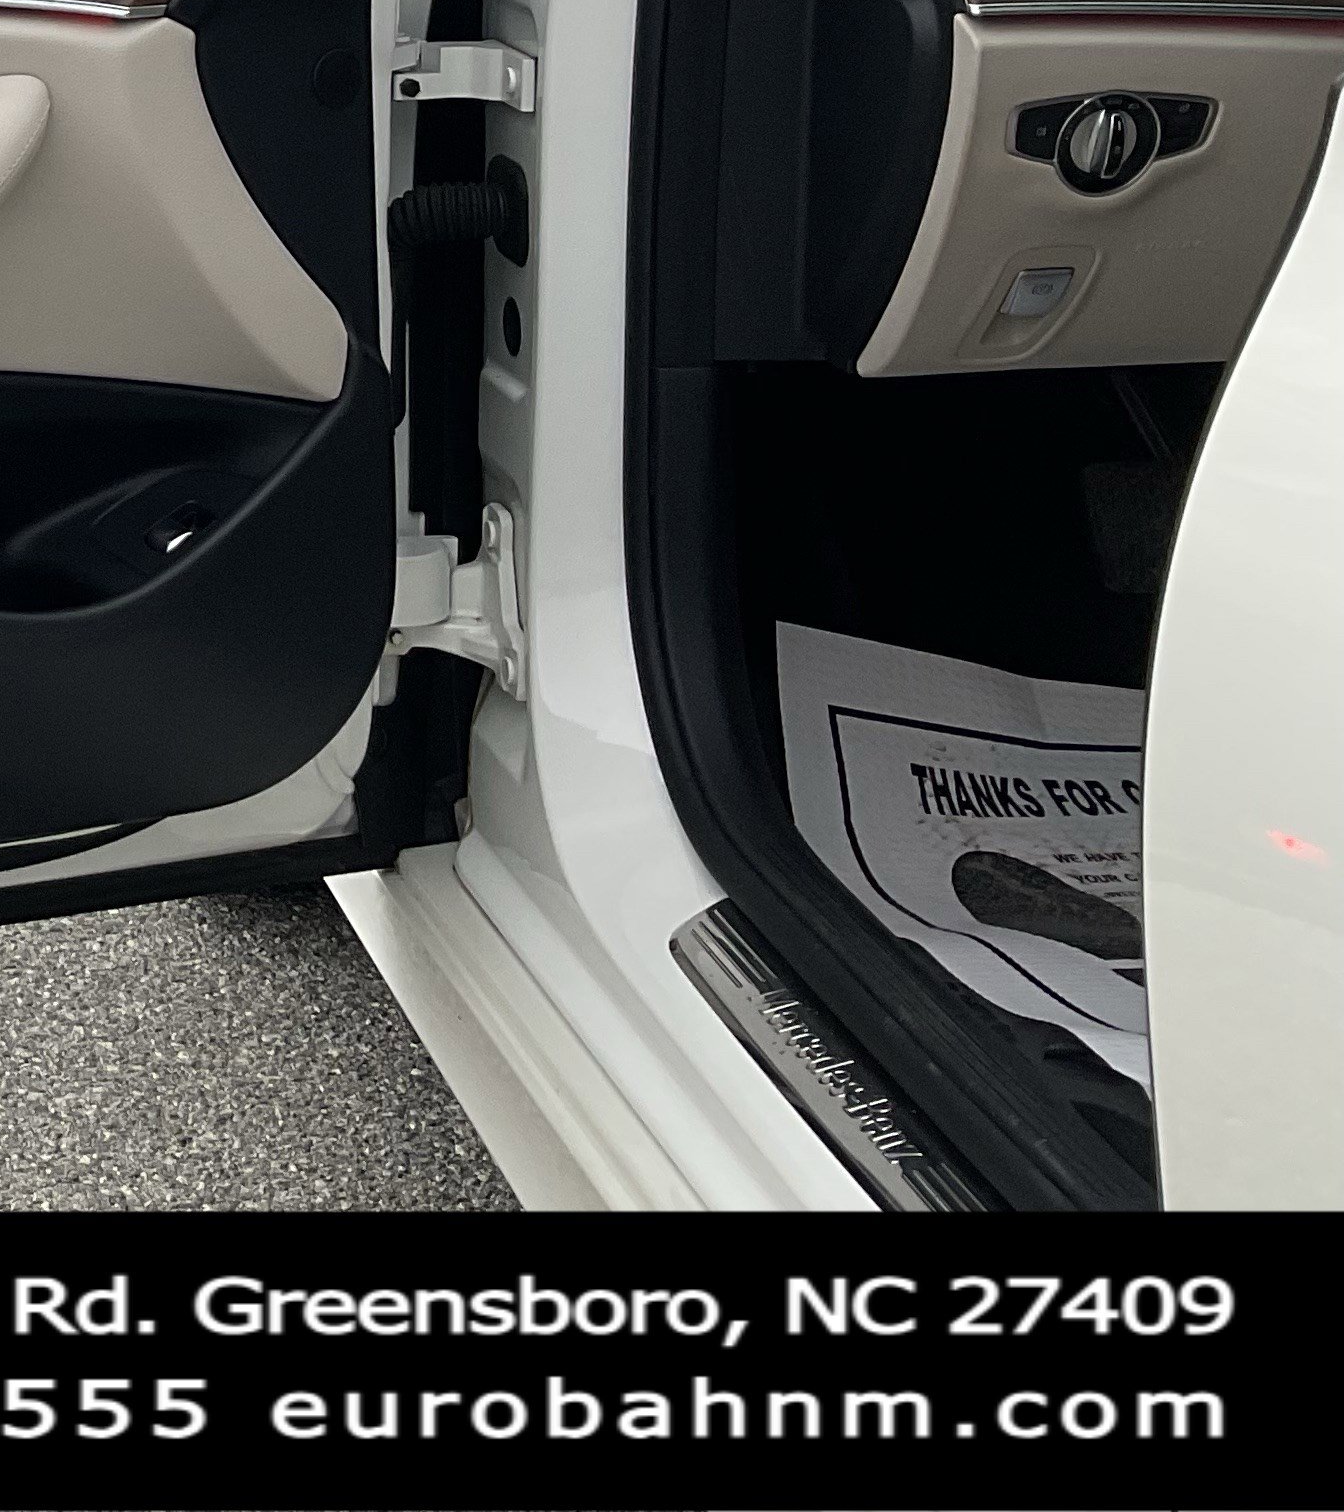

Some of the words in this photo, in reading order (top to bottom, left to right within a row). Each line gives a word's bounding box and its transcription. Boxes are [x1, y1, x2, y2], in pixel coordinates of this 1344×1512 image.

[910, 763, 1046, 818] THANKS
[1042, 779, 1128, 817] FOR
[1054, 853, 1081, 864] WE
[1084, 852, 1128, 863] HAVE
[1074, 873, 1121, 884] YOUR
